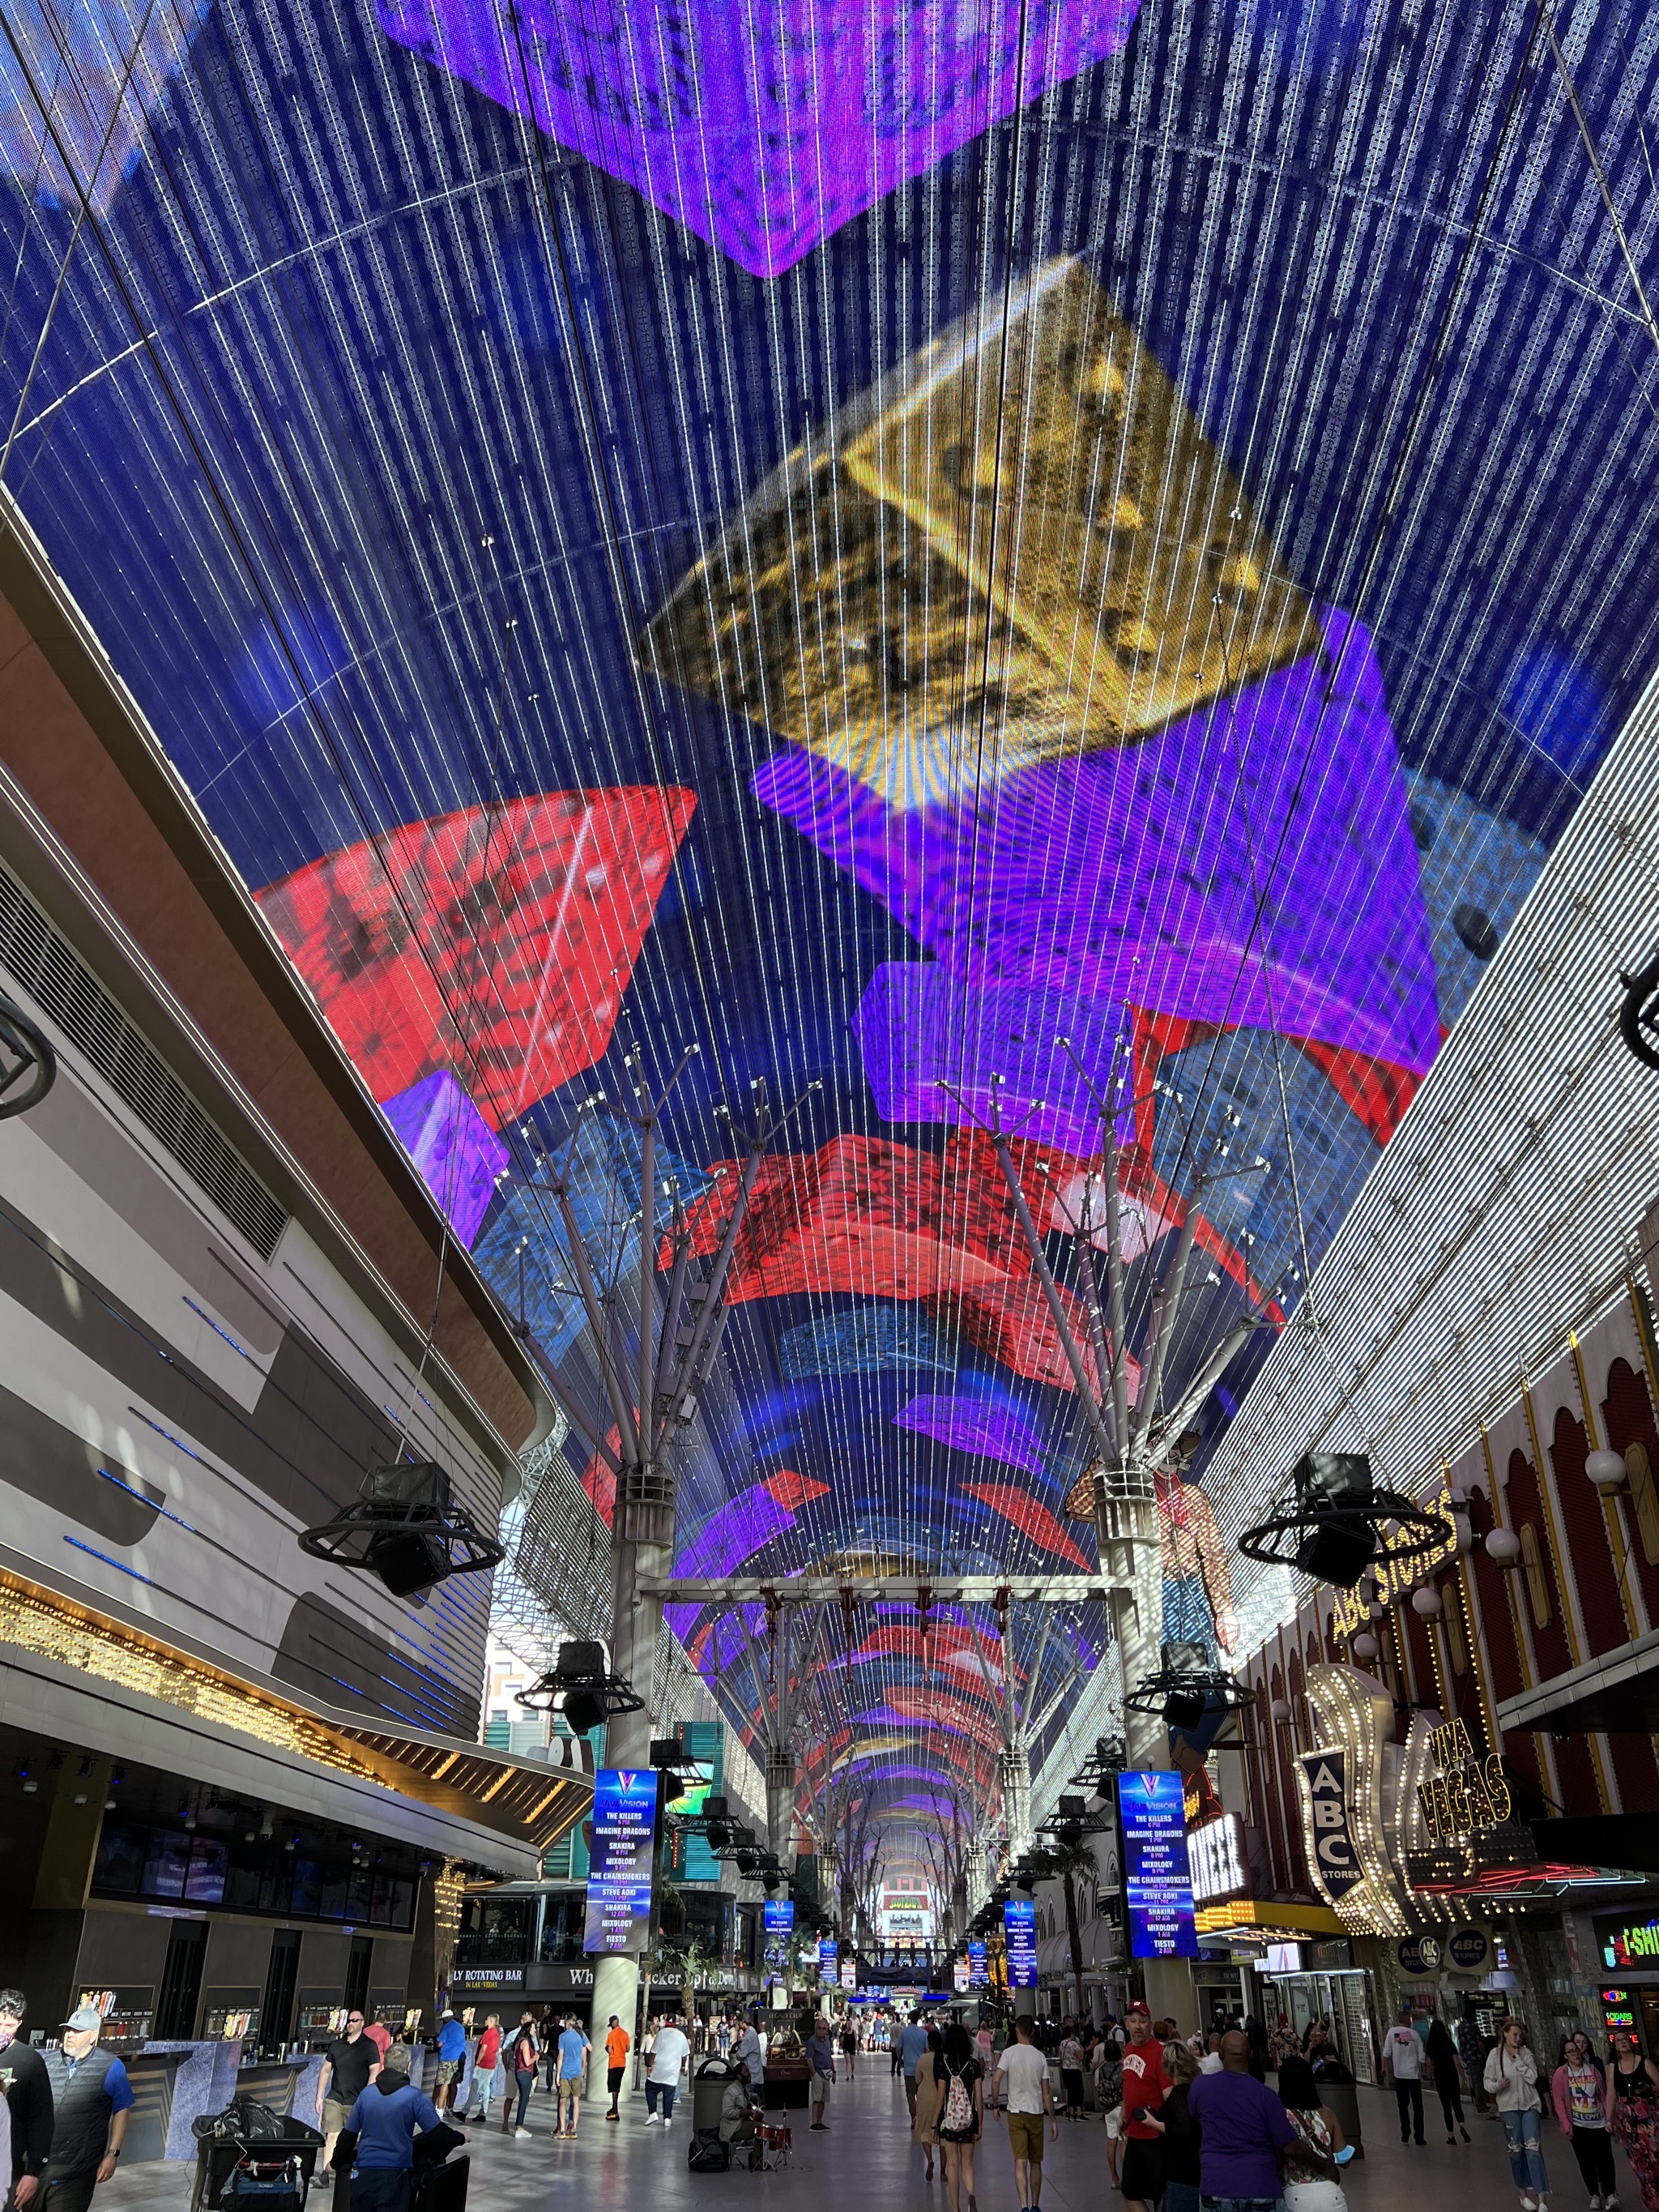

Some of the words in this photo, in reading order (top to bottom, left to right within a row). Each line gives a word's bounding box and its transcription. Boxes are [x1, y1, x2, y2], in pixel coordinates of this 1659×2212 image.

[1427, 1717, 1473, 1769] VIVA
[1417, 1753, 1511, 1839] VEGAS
[606, 1812, 617, 1820] THE
[1135, 1815, 1147, 1823] THE
[1127, 1830, 1154, 1838] IMAGINE
[1142, 1845, 1170, 1853] SHAKIRA
[603, 1873, 650, 1881] CHAINSMOKERS
[1321, 1870, 1361, 1879] STORES
[1142, 1892, 1162, 1900] STEVE
[1162, 1892, 1178, 1900] AOKI
[601, 1919, 633, 1928] MIXOLOGY
[1147, 1924, 1179, 1932] MIXOLOGY
[606, 1935, 627, 1943] TIESTO
[1154, 1940, 1175, 1948] TIESTO
[1453, 1939, 1483, 1950] ABC
[1401, 1946, 1420, 1958] AB
[1423, 1941, 1437, 1957] ABC
[465, 1971, 503, 1980] ROTATING
[505, 1971, 522, 1980] BAR
